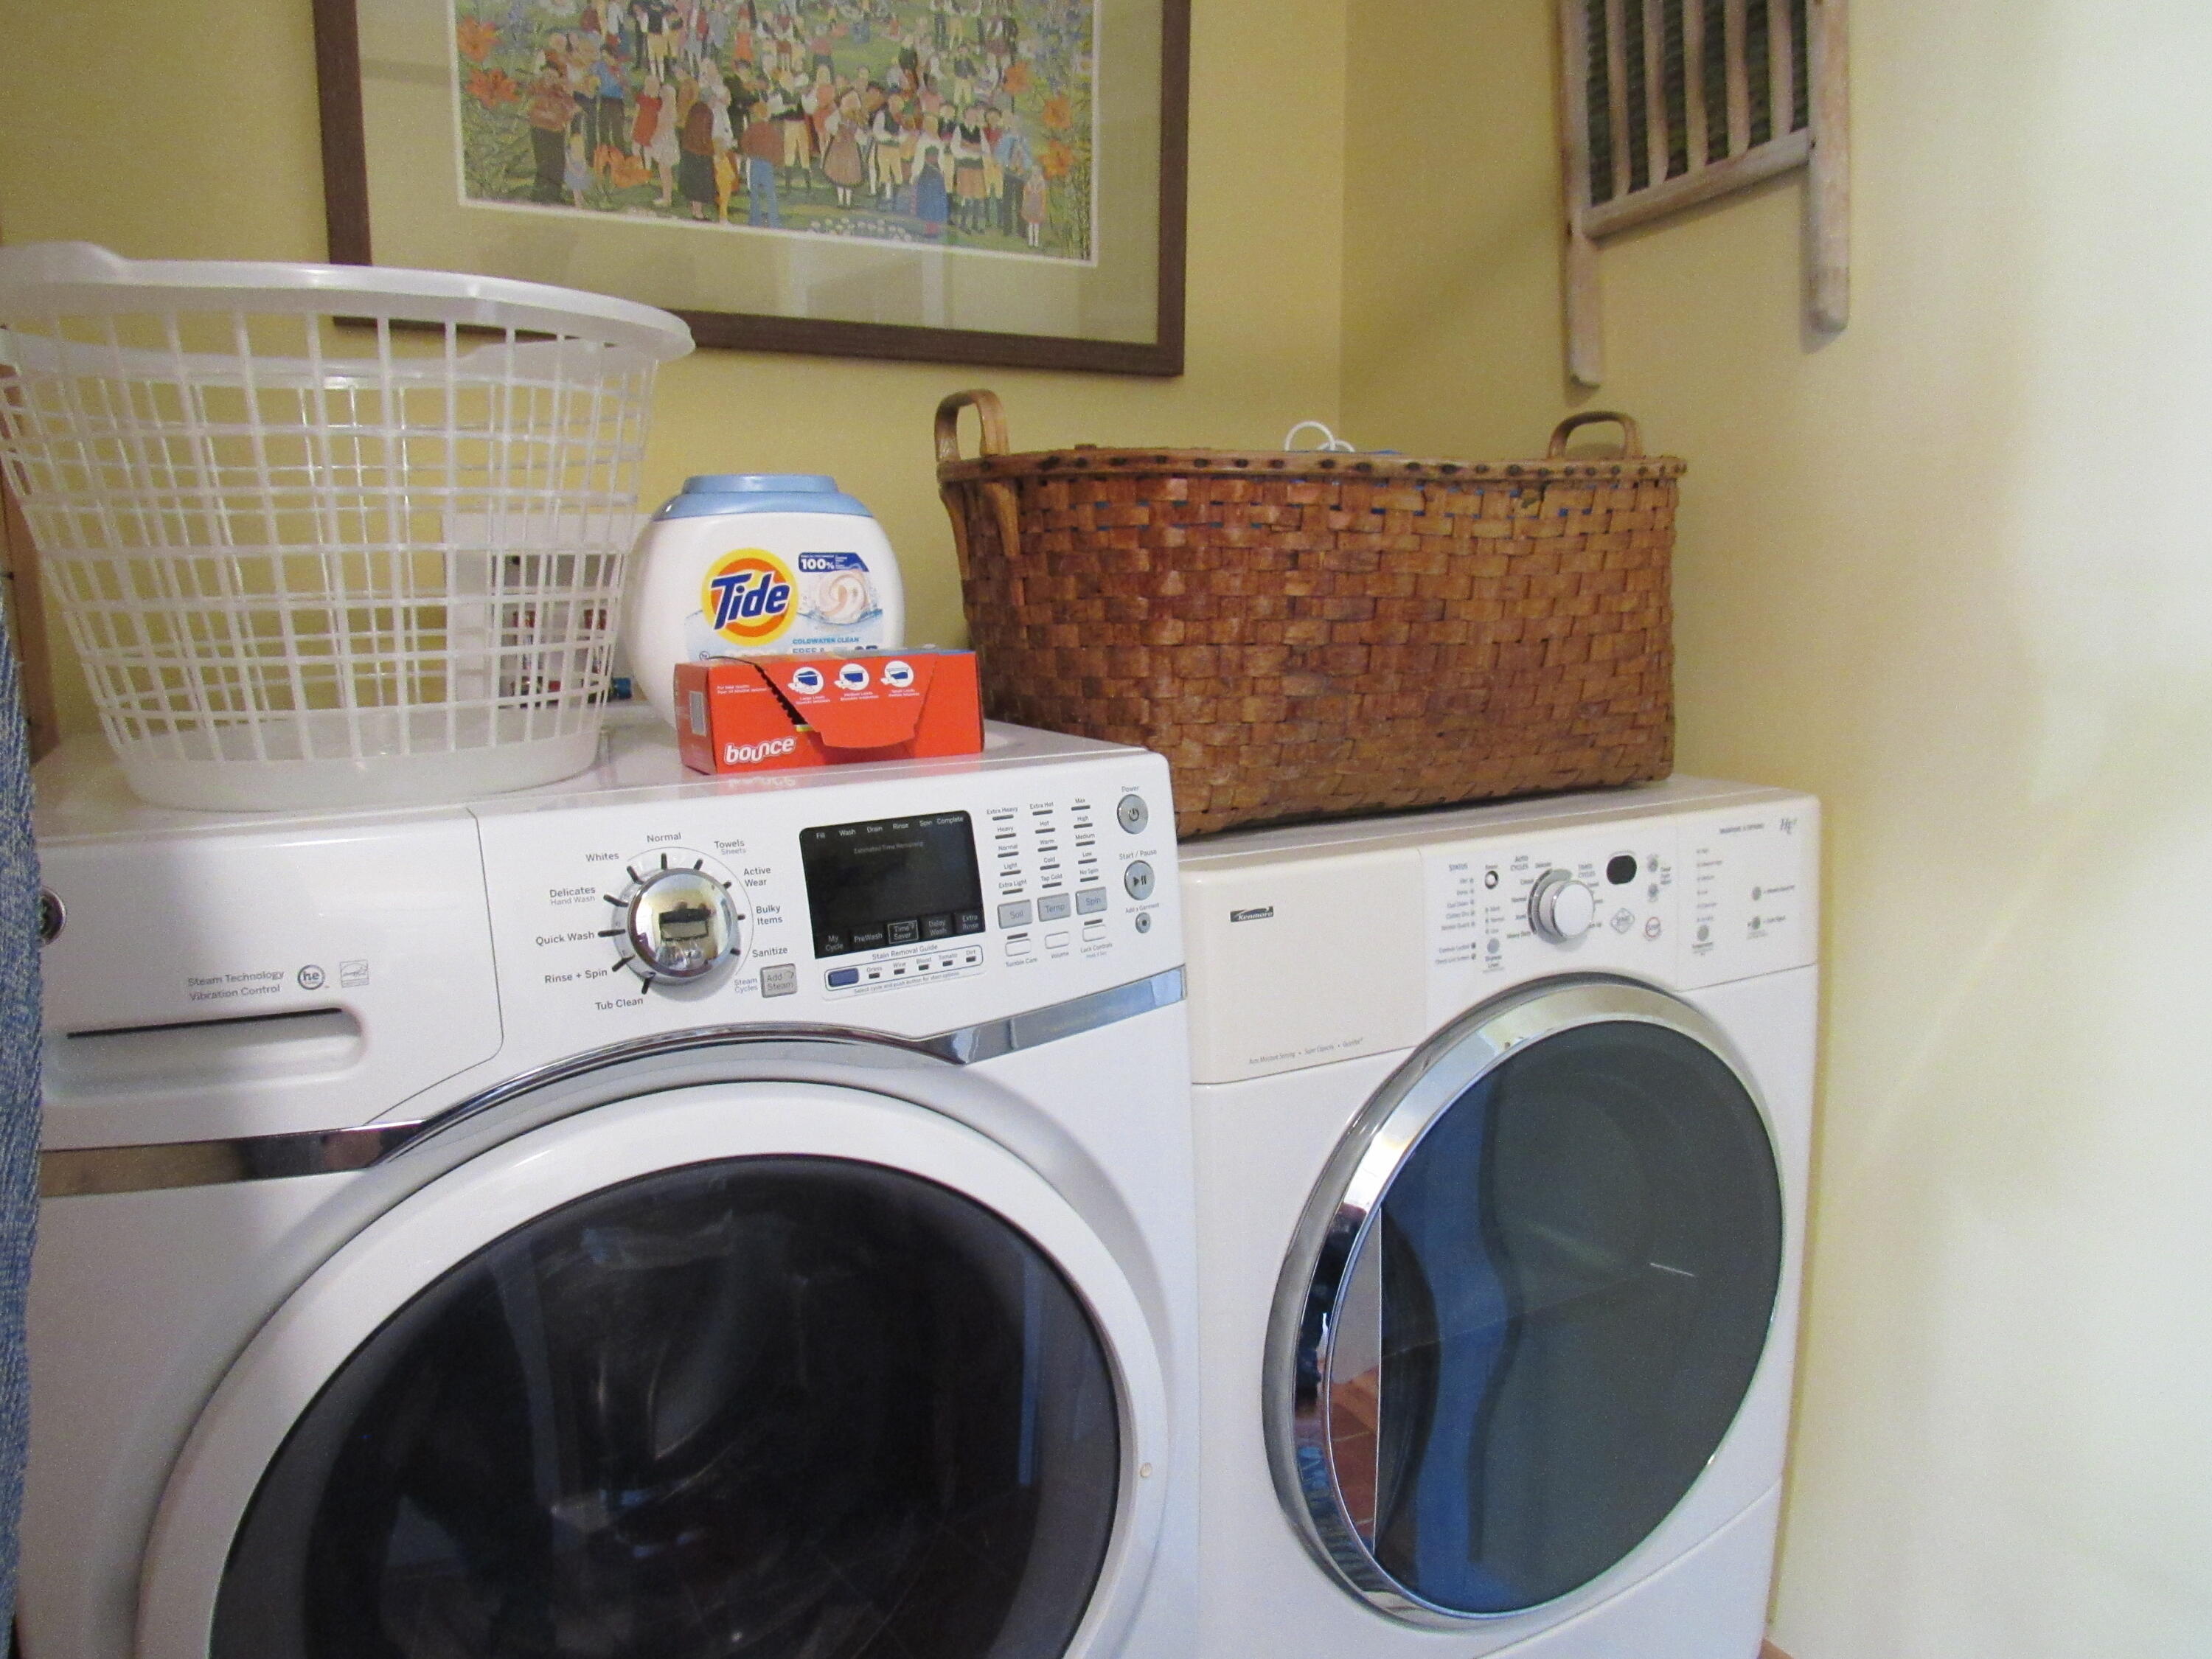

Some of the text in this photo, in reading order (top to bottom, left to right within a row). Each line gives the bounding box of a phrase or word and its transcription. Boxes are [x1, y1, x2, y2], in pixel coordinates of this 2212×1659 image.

[801, 558, 835, 570] 100%
[712, 572, 790, 630] Tide
[725, 737, 796, 765] bounce
[987, 806, 1018, 815] Extra Heavy
[936, 815, 964, 825] Complete
[1077, 815, 1089, 824] High
[839, 828, 856, 837] Wash
[997, 824, 1014, 833] Heavy
[646, 832, 682, 844] Normal
[1075, 832, 1096, 841] Medium
[714, 838, 745, 849] Towels
[1040, 838, 1055, 846] Warm
[721, 848, 747, 856] Sheets
[998, 844, 1018, 852] Normal
[585, 852, 619, 862] Whites
[1119, 851, 1134, 860] Start
[1140, 849, 1158, 857] Pause
[1004, 861, 1018, 870] Light
[743, 866, 771, 876] Active
[1086, 867, 1099, 875] Spin
[1051, 873, 1062, 881] Cold
[745, 878, 767, 887] Wear
[998, 878, 1027, 888] Extra Light
[549, 885, 596, 899] Delicates
[551, 894, 596, 905] Hand Wash
[1085, 897, 1102, 907] Spin
[756, 904, 781, 915] Bulky
[1045, 903, 1065, 914] Temp
[962, 914, 978, 922] Extra
[1009, 910, 1023, 919] Soil
[1239, 912, 1273, 921] Kenmore
[757, 916, 783, 925] Items
[894, 924, 910, 933] Time
[962, 922, 980, 931] Rinse
[894, 931, 911, 940] Saver
[930, 928, 947, 936] Wash
[535, 931, 595, 947] Quick Wash
[827, 935, 838, 943] My
[854, 933, 883, 943] PreWash
[752, 947, 788, 958] Sanitize
[825, 942, 844, 953] Cycle
[872, 944, 939, 961] Stain Removal Guide
[916, 957, 932, 965] Blood
[188, 970, 285, 987] Steam Technology
[303, 970, 320, 981] he
[544, 973, 573, 984] Rinse
[585, 968, 608, 981] Spin
[766, 972, 783, 983] Add
[734, 976, 758, 987] Steam
[767, 981, 793, 992] Steam
[190, 984, 281, 1002] Vibration Control
[734, 984, 758, 995] Cycles
[595, 997, 644, 1010] Tub Clean
